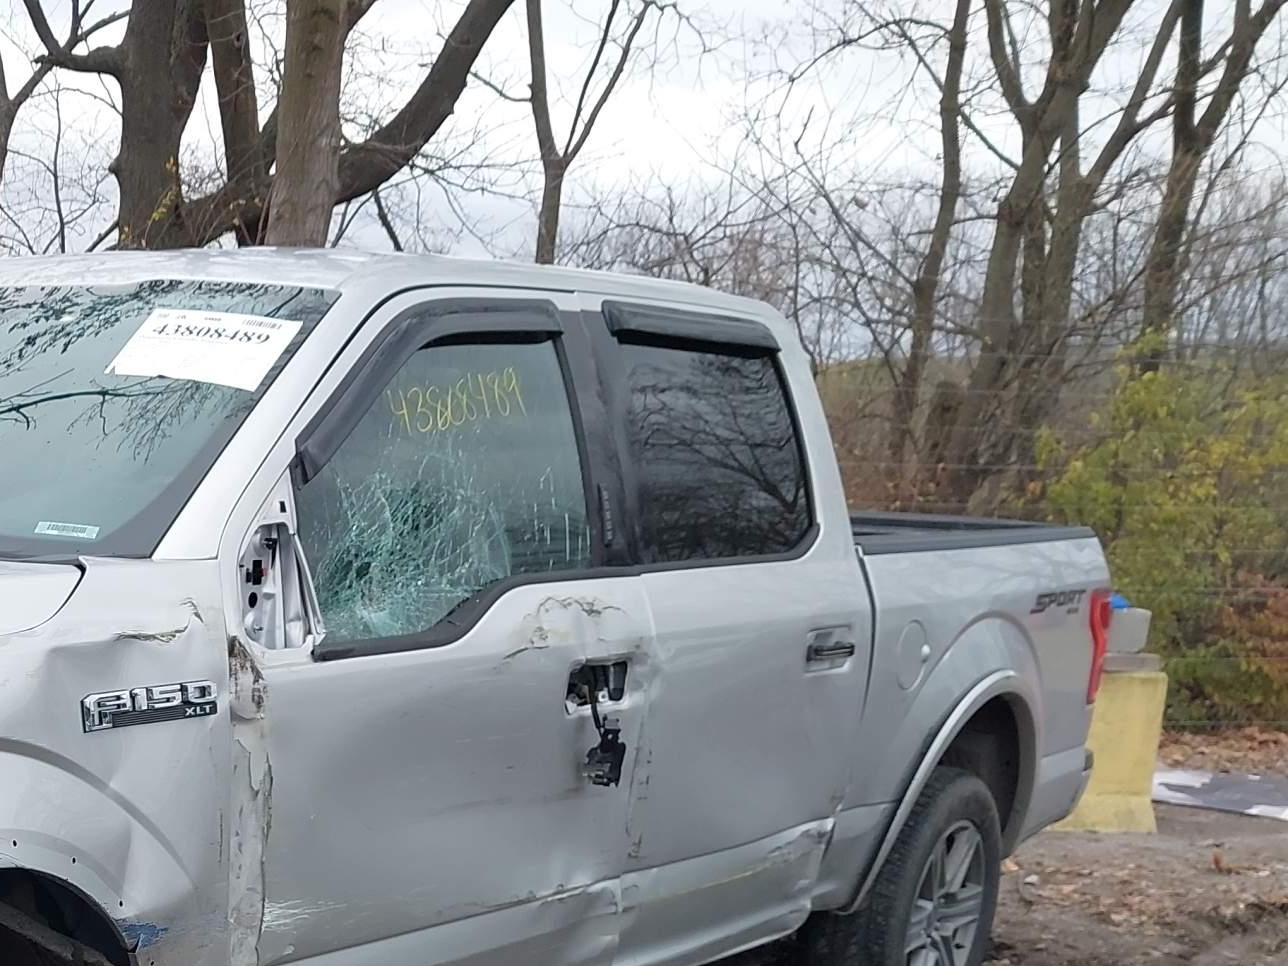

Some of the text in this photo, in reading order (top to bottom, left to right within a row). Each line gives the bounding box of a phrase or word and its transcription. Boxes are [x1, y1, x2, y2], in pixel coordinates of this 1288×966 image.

[152, 322, 271, 345] 43808489
[1030, 589, 1087, 615] SPORT
[185, 704, 213, 717] XLT
